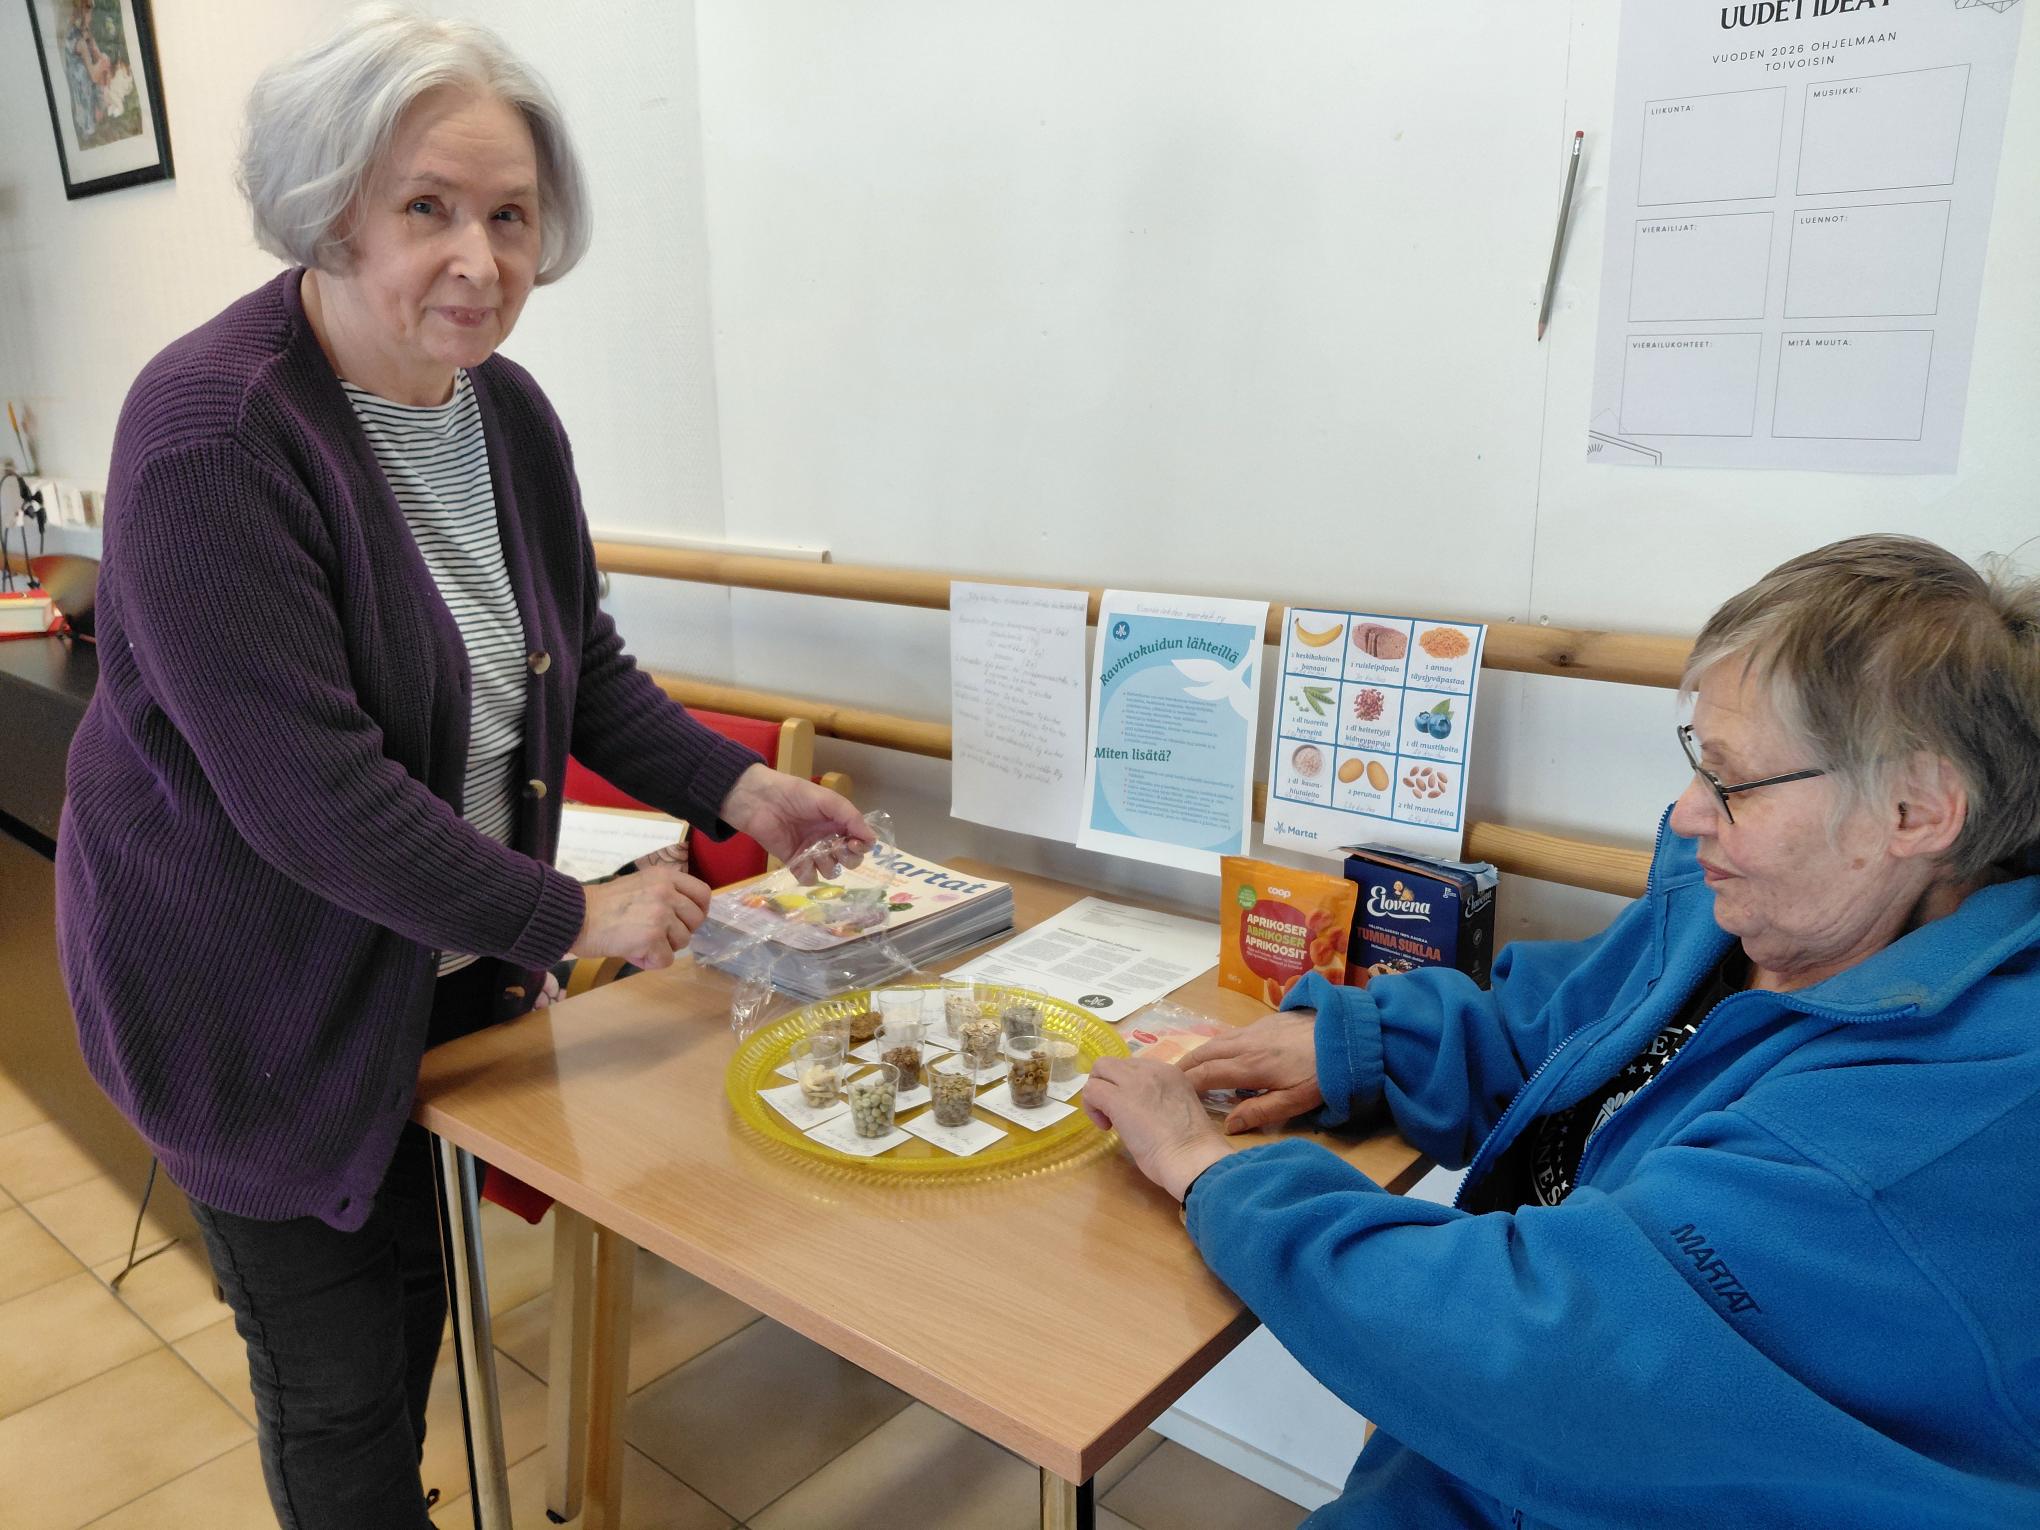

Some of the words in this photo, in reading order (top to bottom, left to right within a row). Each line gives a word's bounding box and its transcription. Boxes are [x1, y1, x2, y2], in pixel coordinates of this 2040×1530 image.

[1720, 0, 1804, 30] UUDET
[1712, 49, 1766, 64] VUODEN
[1771, 44, 1804, 57] 2026
[1811, 31, 1897, 52] OHJELMAAN
[1765, 55, 1835, 72] TOIVOISIN
[1813, 86, 1862, 98] MUSIIKKI:
[1650, 104, 1694, 116] LIIKUNTA:
[1800, 215, 1849, 225] LUENNOT:
[1641, 224, 1698, 234] VIERAILIJAT:
[1632, 341, 1713, 349] VIERAILUKOHTEET:
[1100, 637, 1183, 687] Ravintokuidun
[1187, 636, 1240, 664] lähteillä
[1355, 660, 1400, 673] ruisleipäpala
[1431, 665, 1453, 673] annos
[1410, 673, 1465, 686] täysjyväpastaa
[1303, 717, 1329, 728] tuoreita
[1345, 734, 1391, 748] kidneypapuja
[1411, 740, 1419, 748] dl
[1419, 741, 1459, 754] mustikoita
[1094, 747, 1129, 760] Miten
[1132, 748, 1172, 762] lisätä?
[1352, 790, 1381, 800] perunaa
[1415, 804, 1455, 817] manteleita
[1287, 826, 1318, 840] Martat
[1267, 886, 1292, 898] coop
[1366, 885, 1431, 920] Elovena
[1247, 914, 1308, 938] APRIKOSER
[1247, 925, 1306, 949] ABRIKOSER
[1357, 926, 1398, 949] TUMMA
[1398, 938, 1442, 962] SUKLAA
[1245, 935, 1308, 960] APRIKOOSIT
[1670, 1223, 1761, 1315] MARTAT
